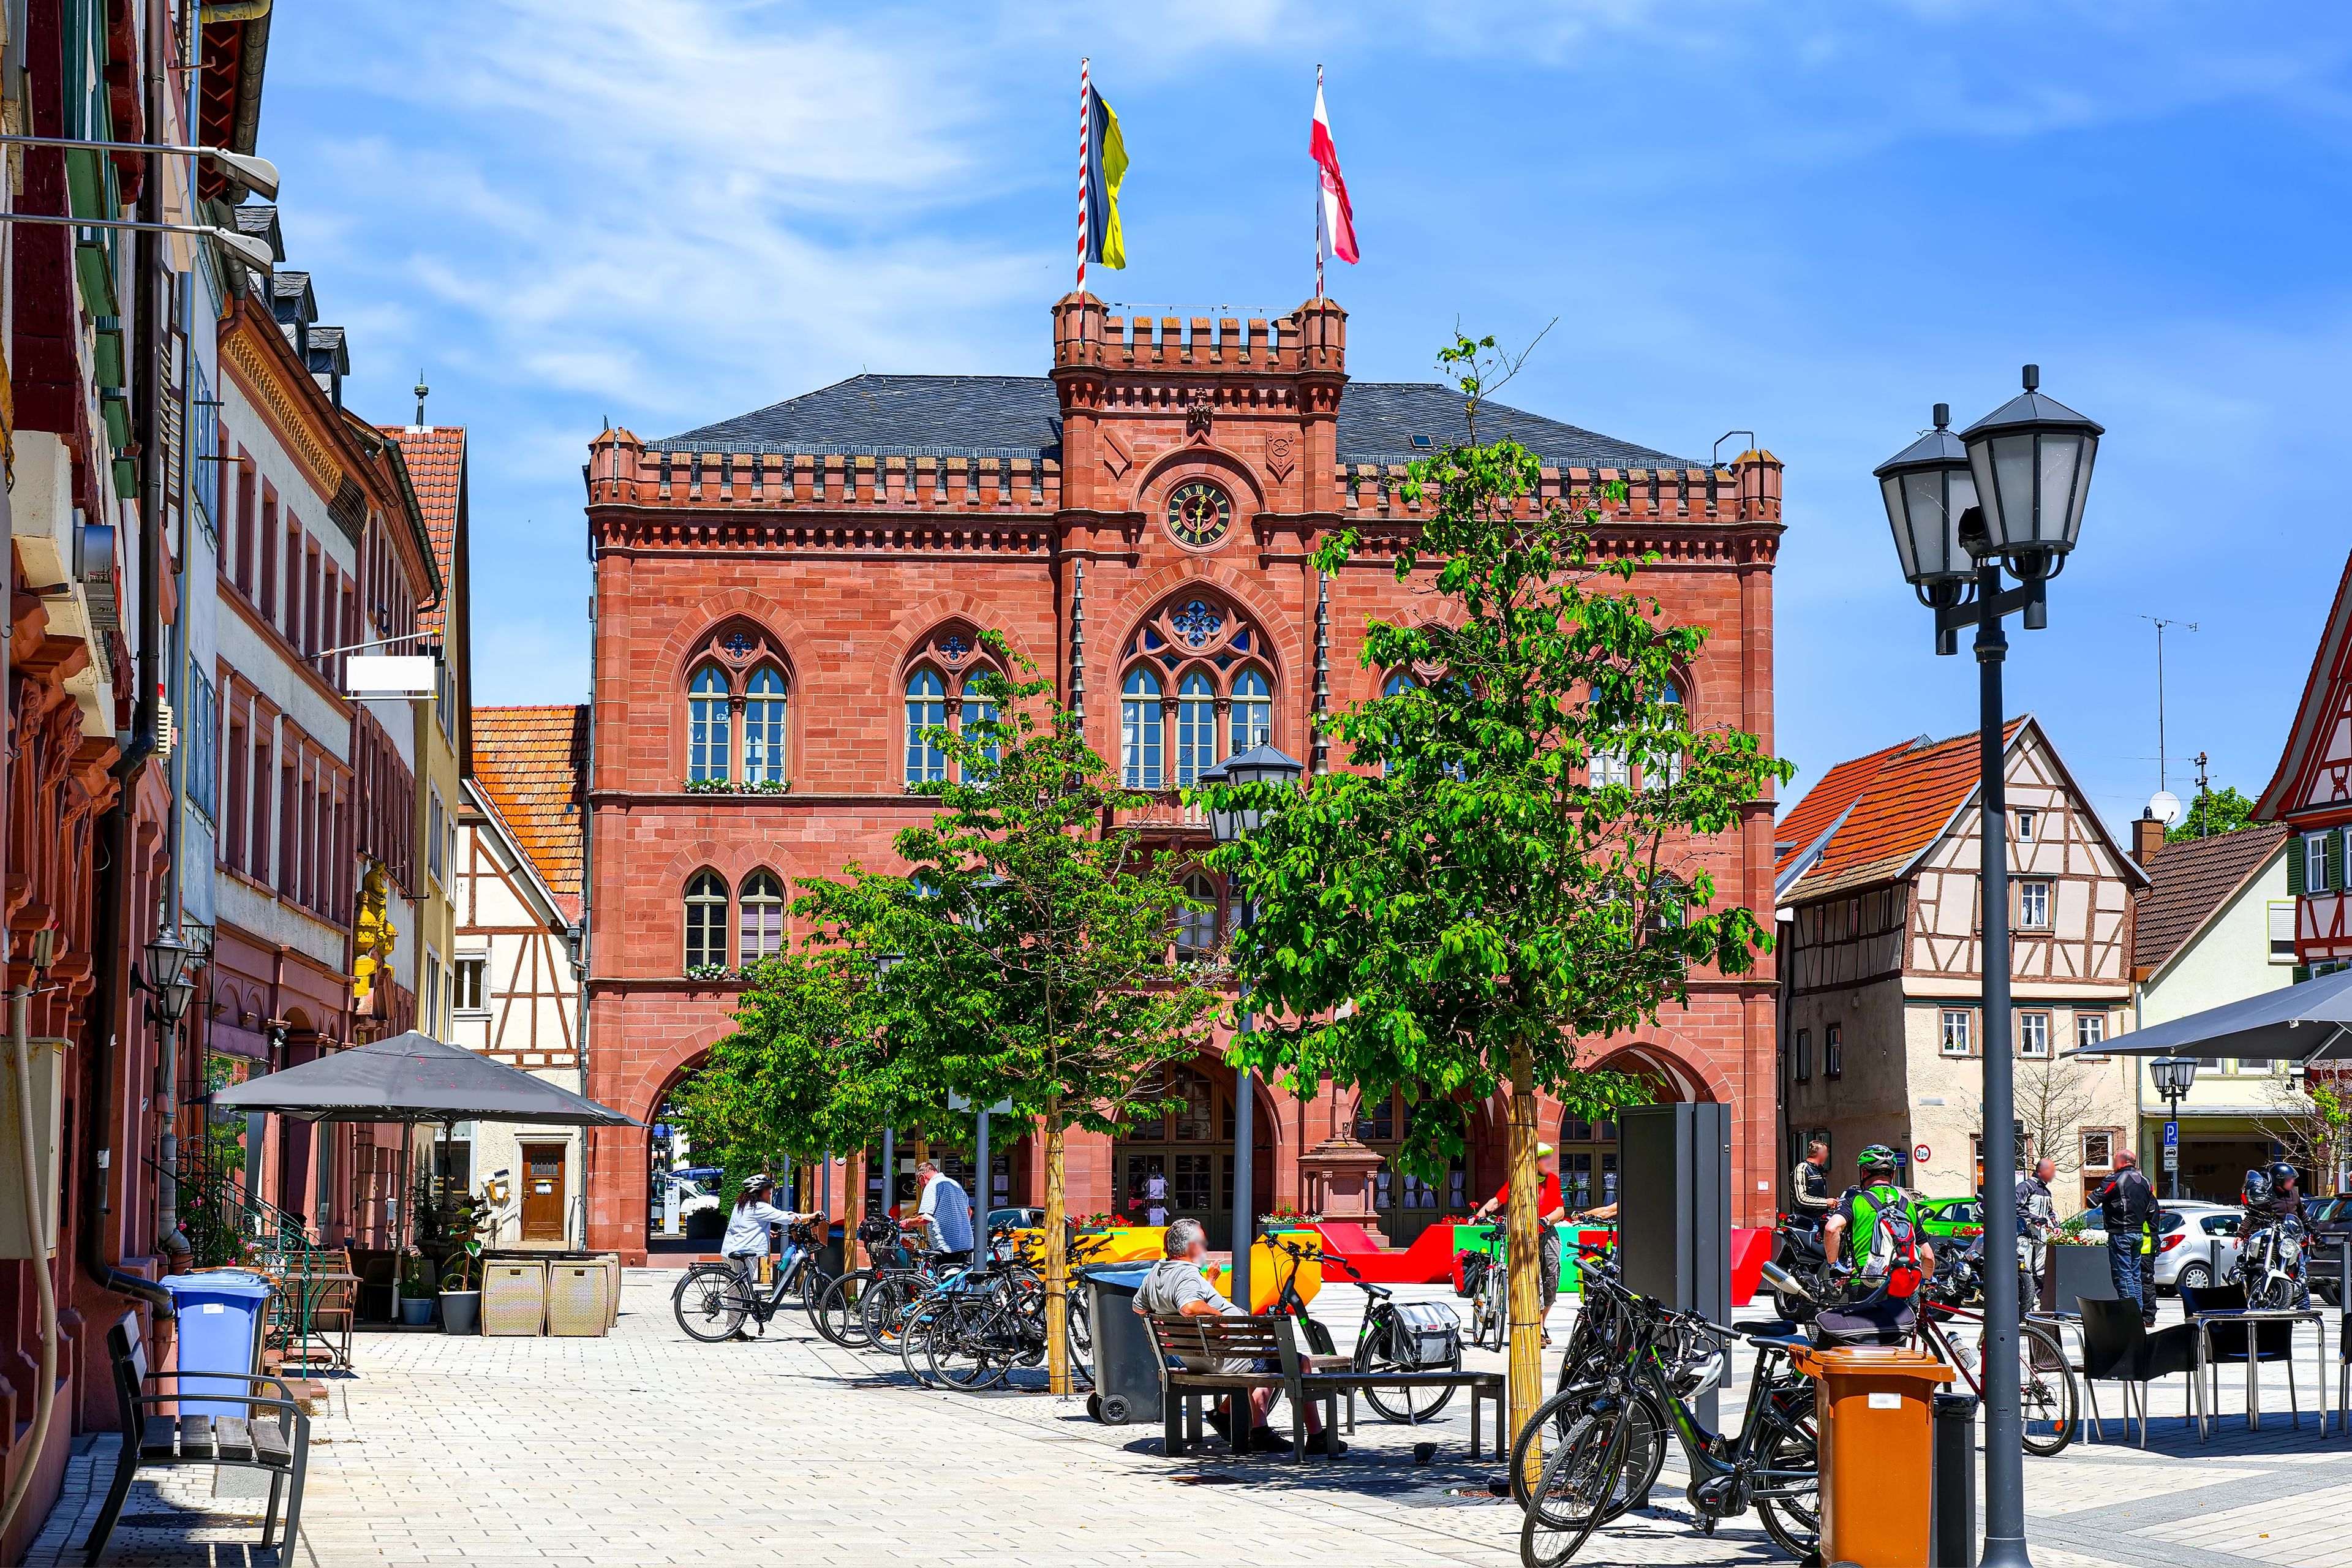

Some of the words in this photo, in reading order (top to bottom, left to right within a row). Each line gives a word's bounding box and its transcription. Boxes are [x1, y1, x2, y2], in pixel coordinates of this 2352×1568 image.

[1182, 487, 1193, 498] XI
[1195, 484, 1204, 494] XII
[1209, 489, 1216, 498] I
[1172, 496, 1183, 505] X
[2167, 1125, 2174, 1143] P
